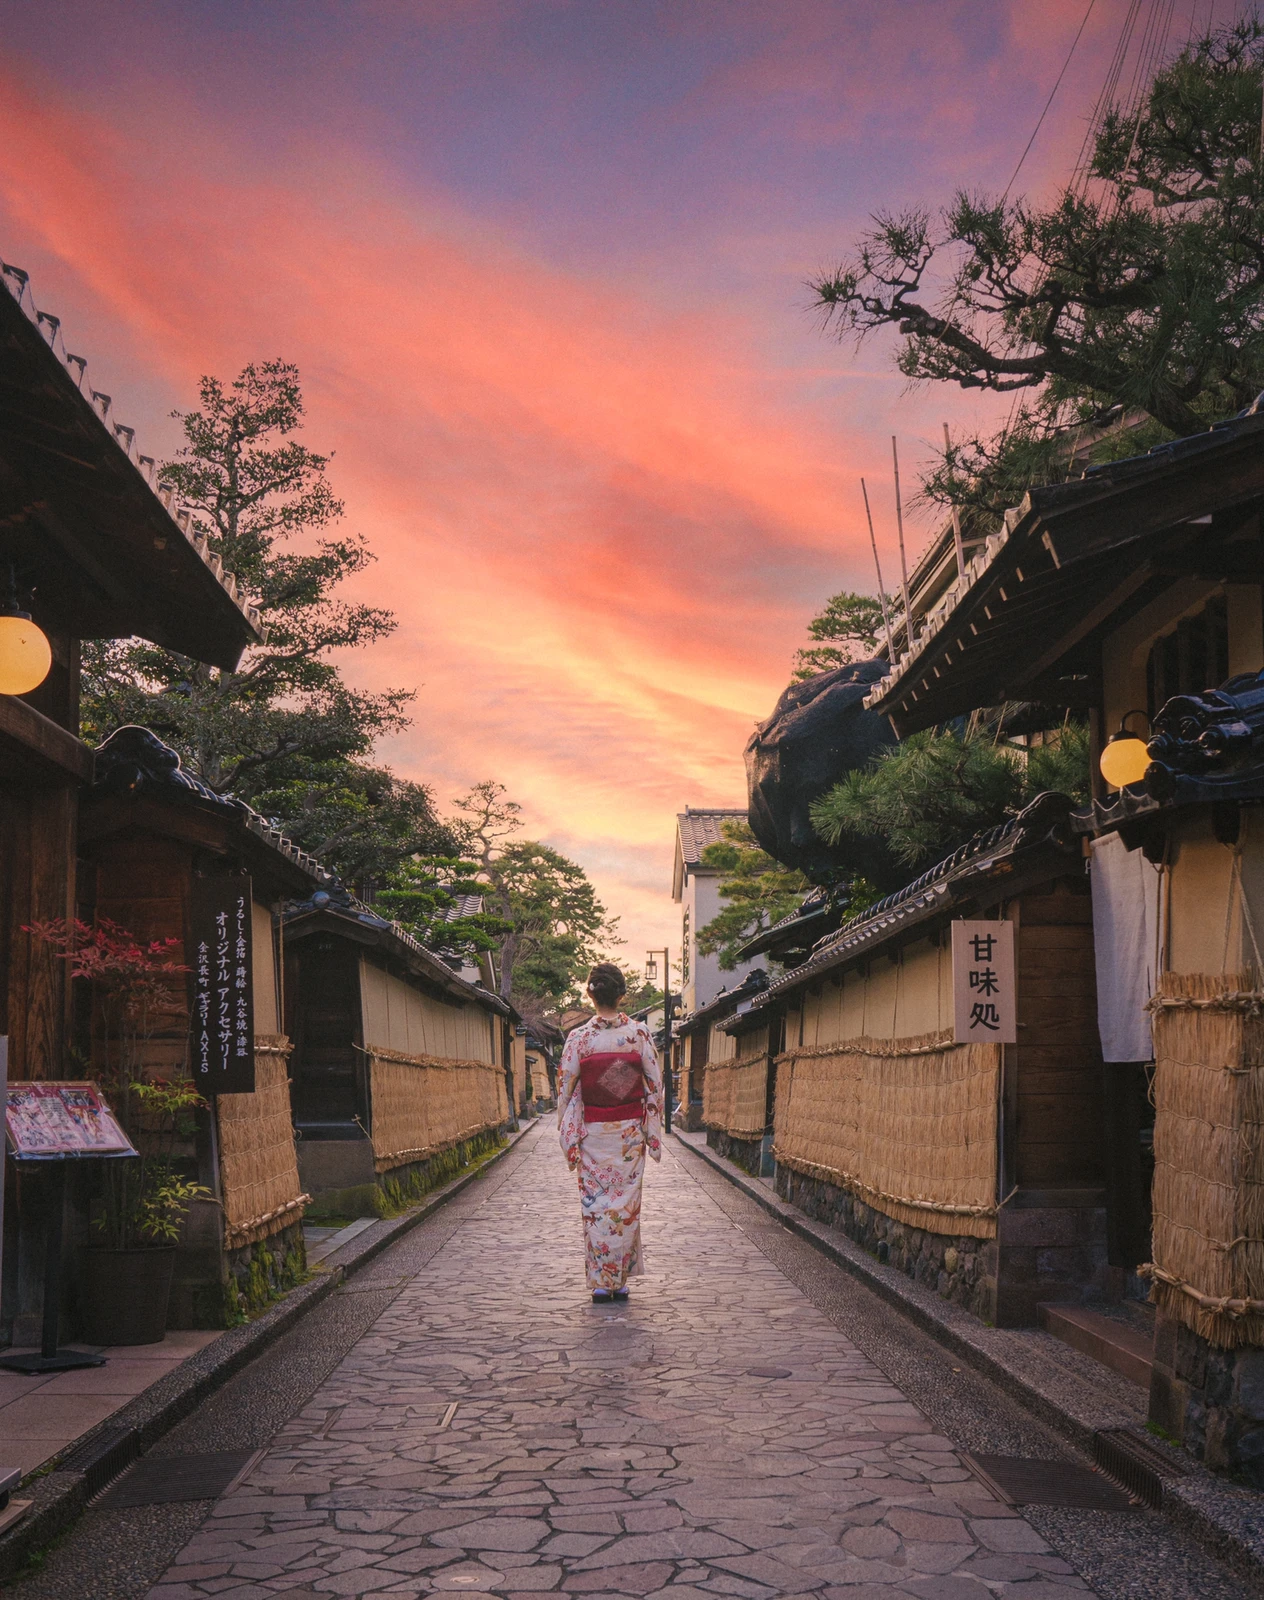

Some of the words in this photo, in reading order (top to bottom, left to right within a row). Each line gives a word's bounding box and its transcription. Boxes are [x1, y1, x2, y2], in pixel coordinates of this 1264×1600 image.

[198, 941, 210, 987] 金沢長町
[216, 911, 231, 981] オリジナル
[968, 933, 1000, 1031] 甘味処
[200, 1030, 209, 1073] AXIS
[217, 987, 233, 1070] アクセサリー
